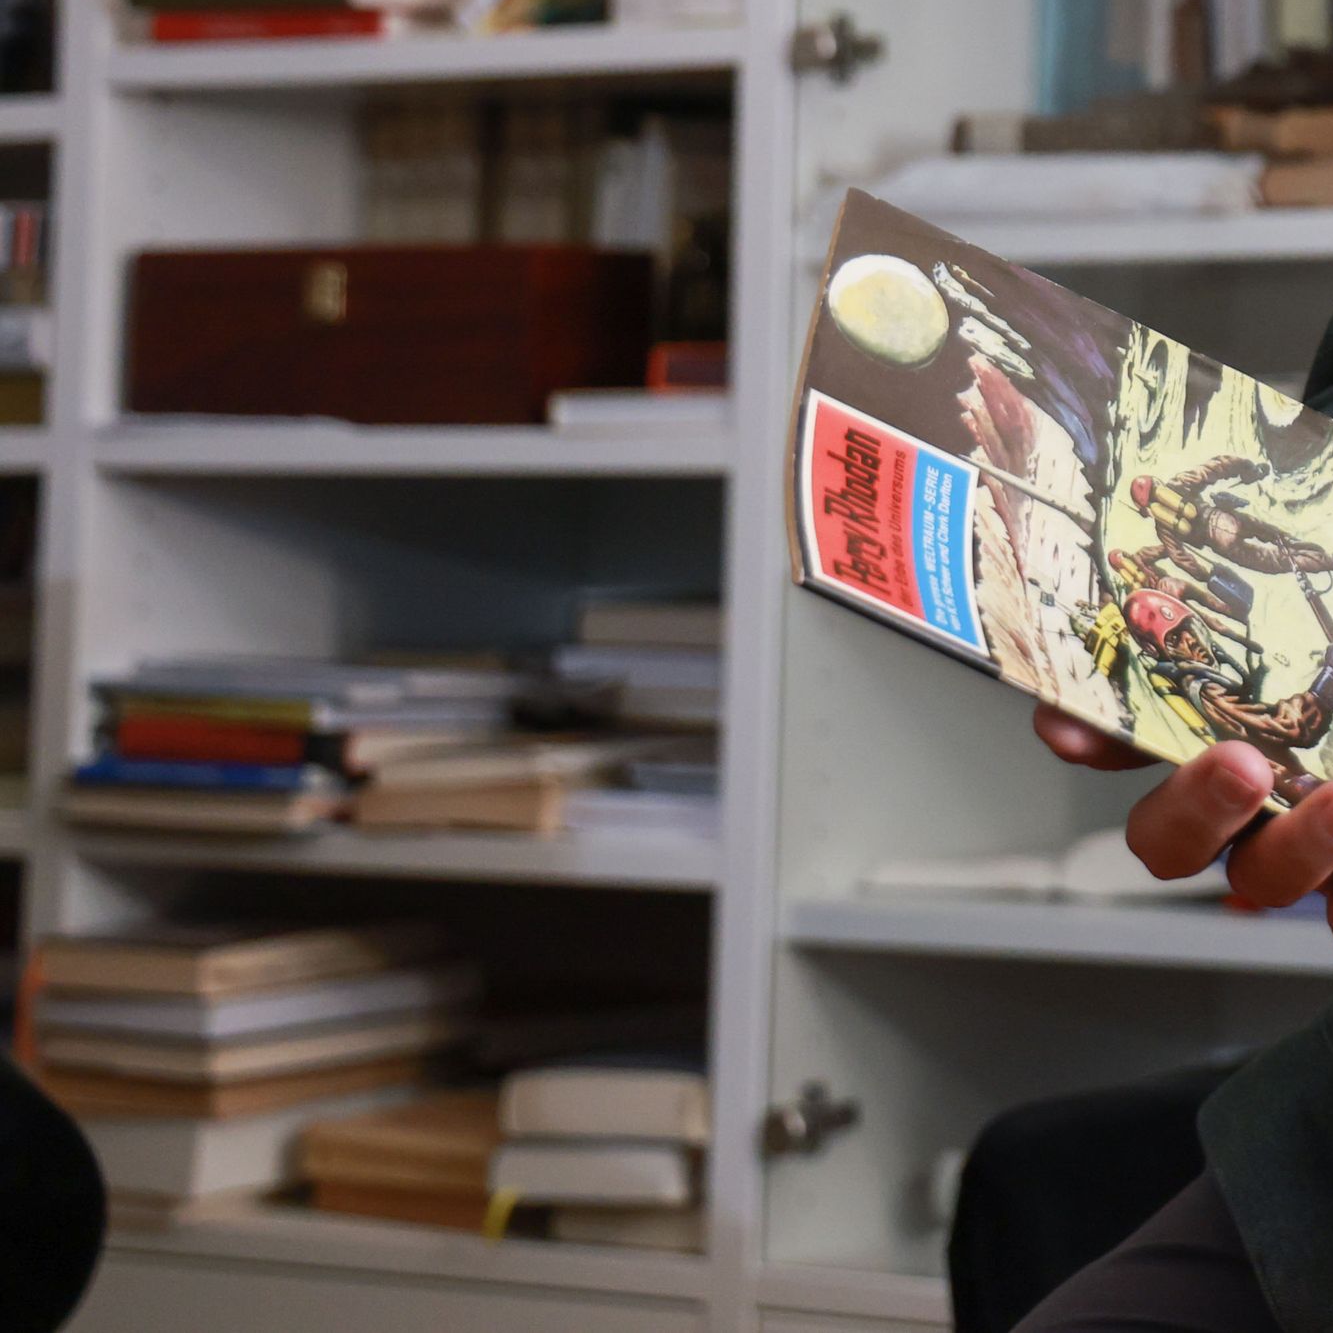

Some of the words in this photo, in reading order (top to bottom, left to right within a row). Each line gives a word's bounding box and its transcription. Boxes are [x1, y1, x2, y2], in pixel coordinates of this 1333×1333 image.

[824, 427, 882, 533] Rhodan
[888, 450, 907, 532] Universums
[937, 473, 953, 511] Darlton
[891, 534, 906, 558] des
[936, 513, 950, 548] Clark
[833, 521, 891, 597] Perry
[938, 550, 950, 570] und
